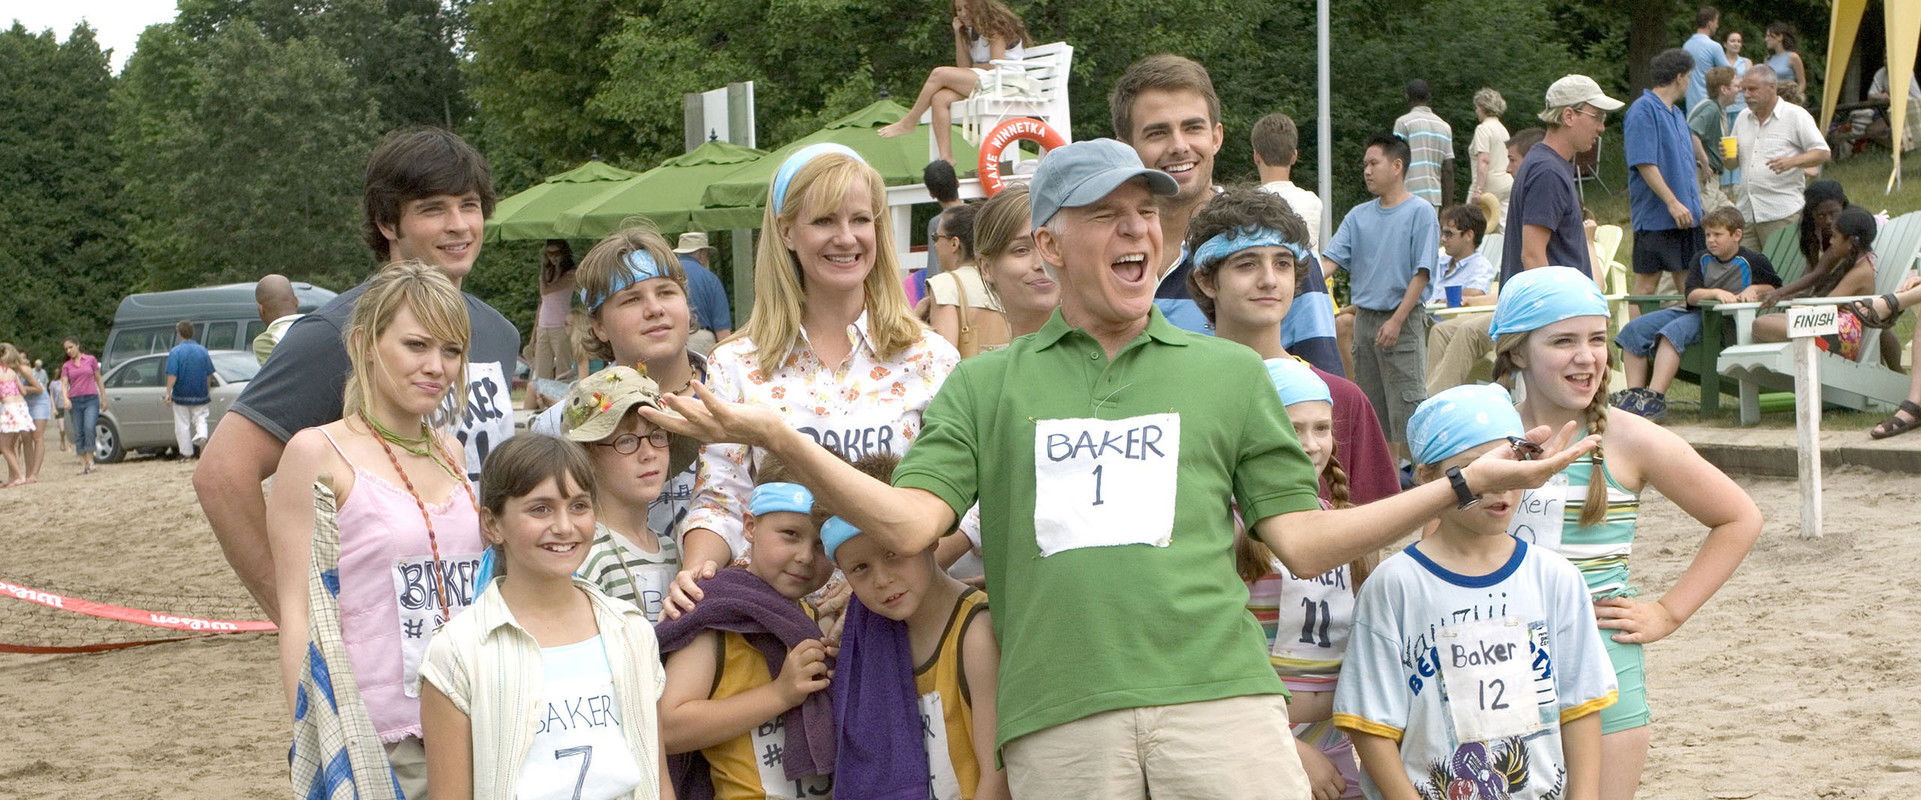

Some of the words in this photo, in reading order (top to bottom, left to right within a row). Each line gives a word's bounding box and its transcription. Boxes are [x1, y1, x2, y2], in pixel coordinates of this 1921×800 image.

[991, 122, 1046, 149] WINNETKA
[986, 153, 1003, 189] LAKE
[1793, 312, 1835, 328] FINISH
[1046, 425, 1165, 462] BAKER
[1092, 464, 1104, 506] 1
[1518, 488, 1557, 515] ker
[1299, 596, 1331, 648] 11
[1450, 640, 1517, 669] Baker
[1479, 678, 1510, 711] 12
[554, 744, 593, 800] 7
